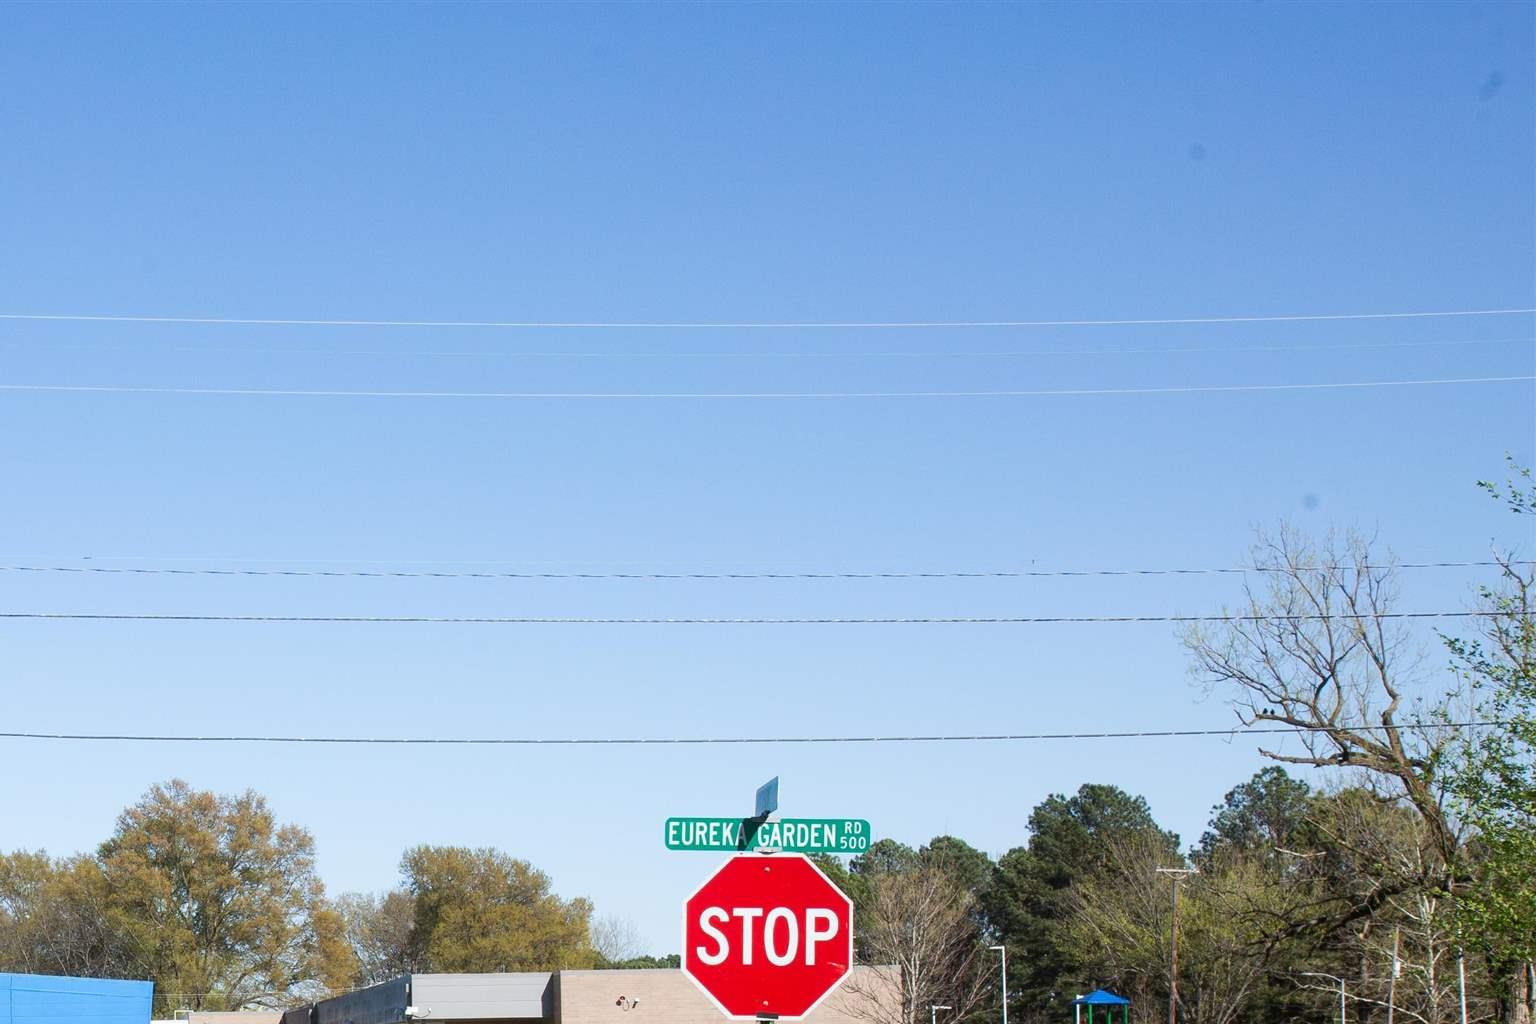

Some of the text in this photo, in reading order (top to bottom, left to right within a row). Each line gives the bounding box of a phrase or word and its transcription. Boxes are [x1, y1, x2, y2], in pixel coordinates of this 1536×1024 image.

[668, 821, 862, 848] EUREKA GARDEN RD
[839, 836, 866, 849] 500
[696, 906, 839, 966] STOP
